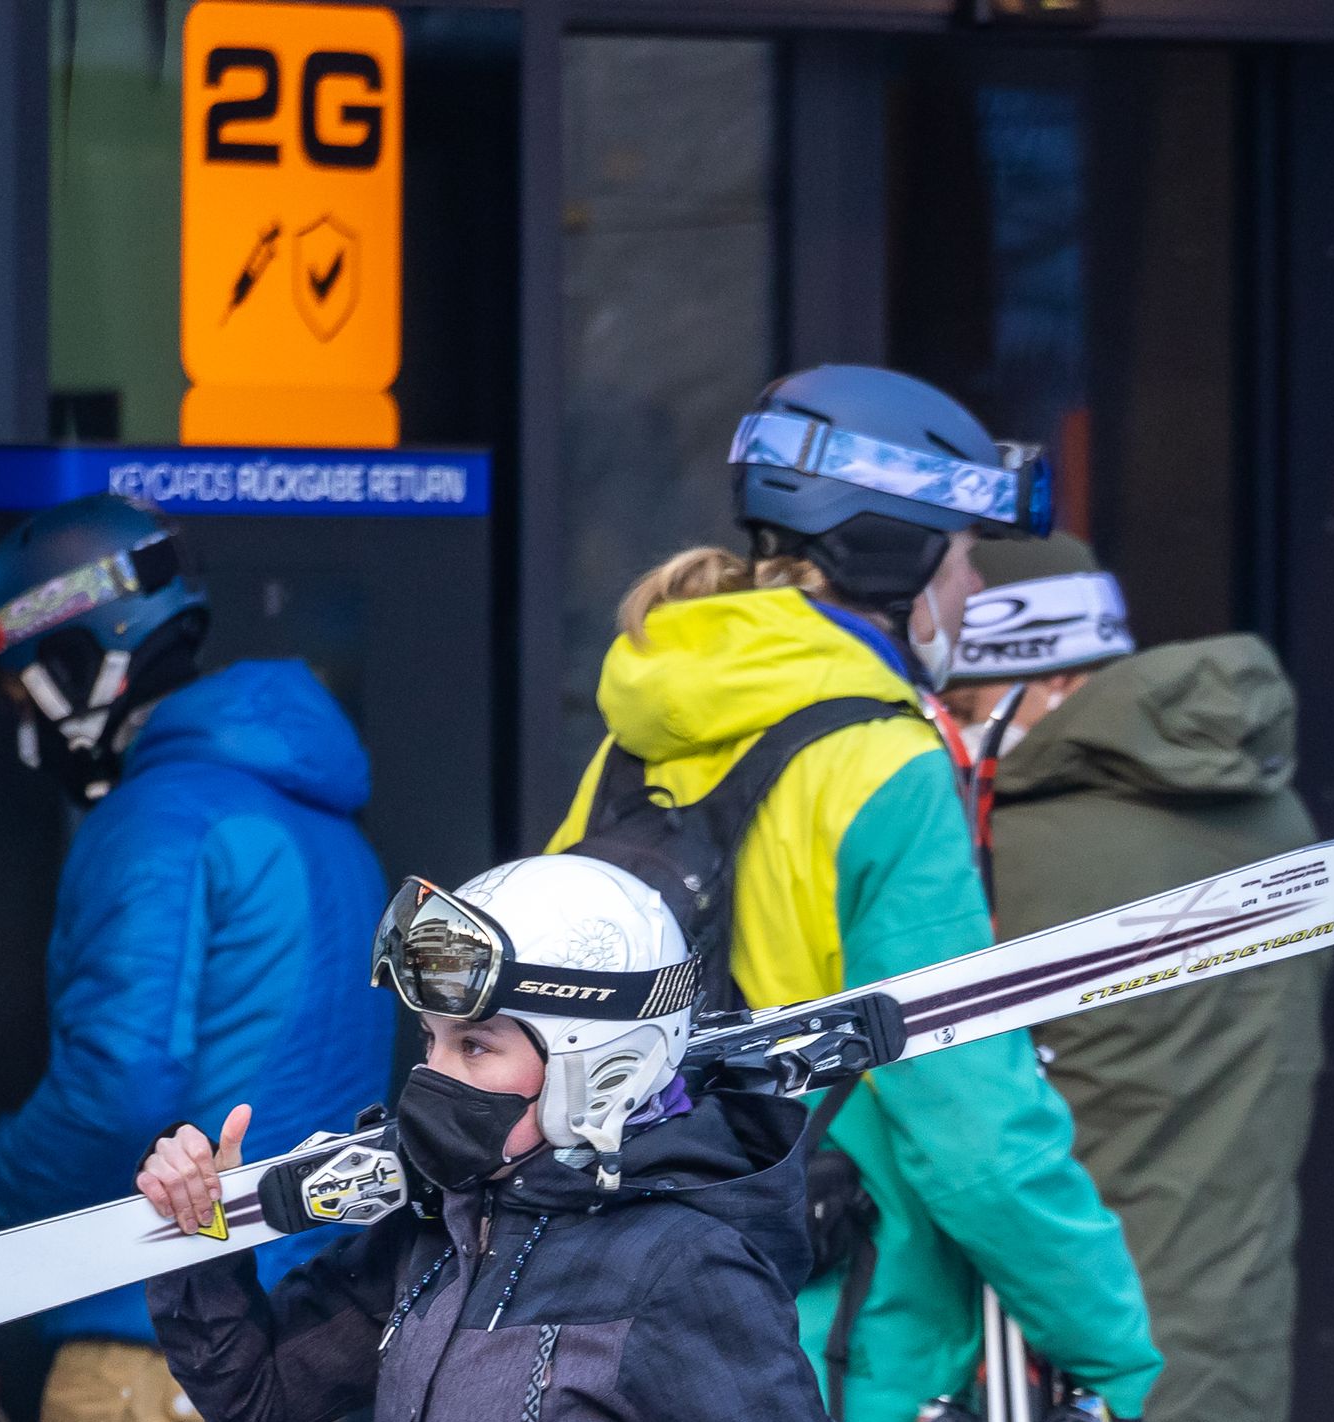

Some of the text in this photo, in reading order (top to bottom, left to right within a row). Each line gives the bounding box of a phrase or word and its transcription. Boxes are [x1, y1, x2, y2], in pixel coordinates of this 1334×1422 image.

[204, 46, 385, 169] 2G
[236, 457, 364, 502] RÜCKGABE
[367, 464, 467, 503] RETURN
[961, 633, 1060, 664] OAKLEY
[513, 980, 617, 1002] SCOTT
[1077, 972, 1181, 1006] REBELS
